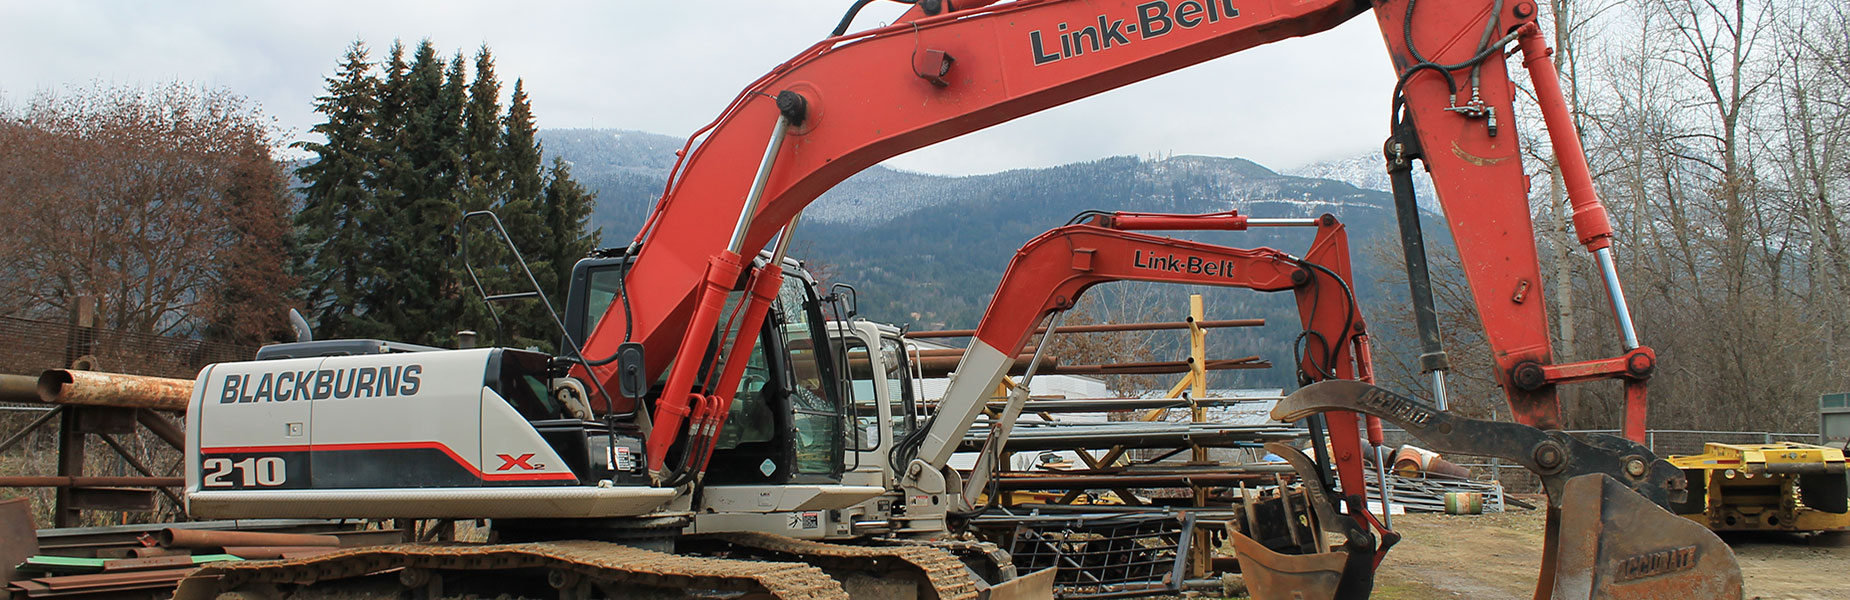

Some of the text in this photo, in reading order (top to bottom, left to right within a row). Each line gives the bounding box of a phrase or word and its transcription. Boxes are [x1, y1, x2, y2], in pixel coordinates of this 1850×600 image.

[1029, 0, 1239, 66] Link-Belt
[1133, 250, 1234, 278] Link-Belt
[220, 364, 423, 404] BLACKBURNS
[203, 457, 286, 487] 210
